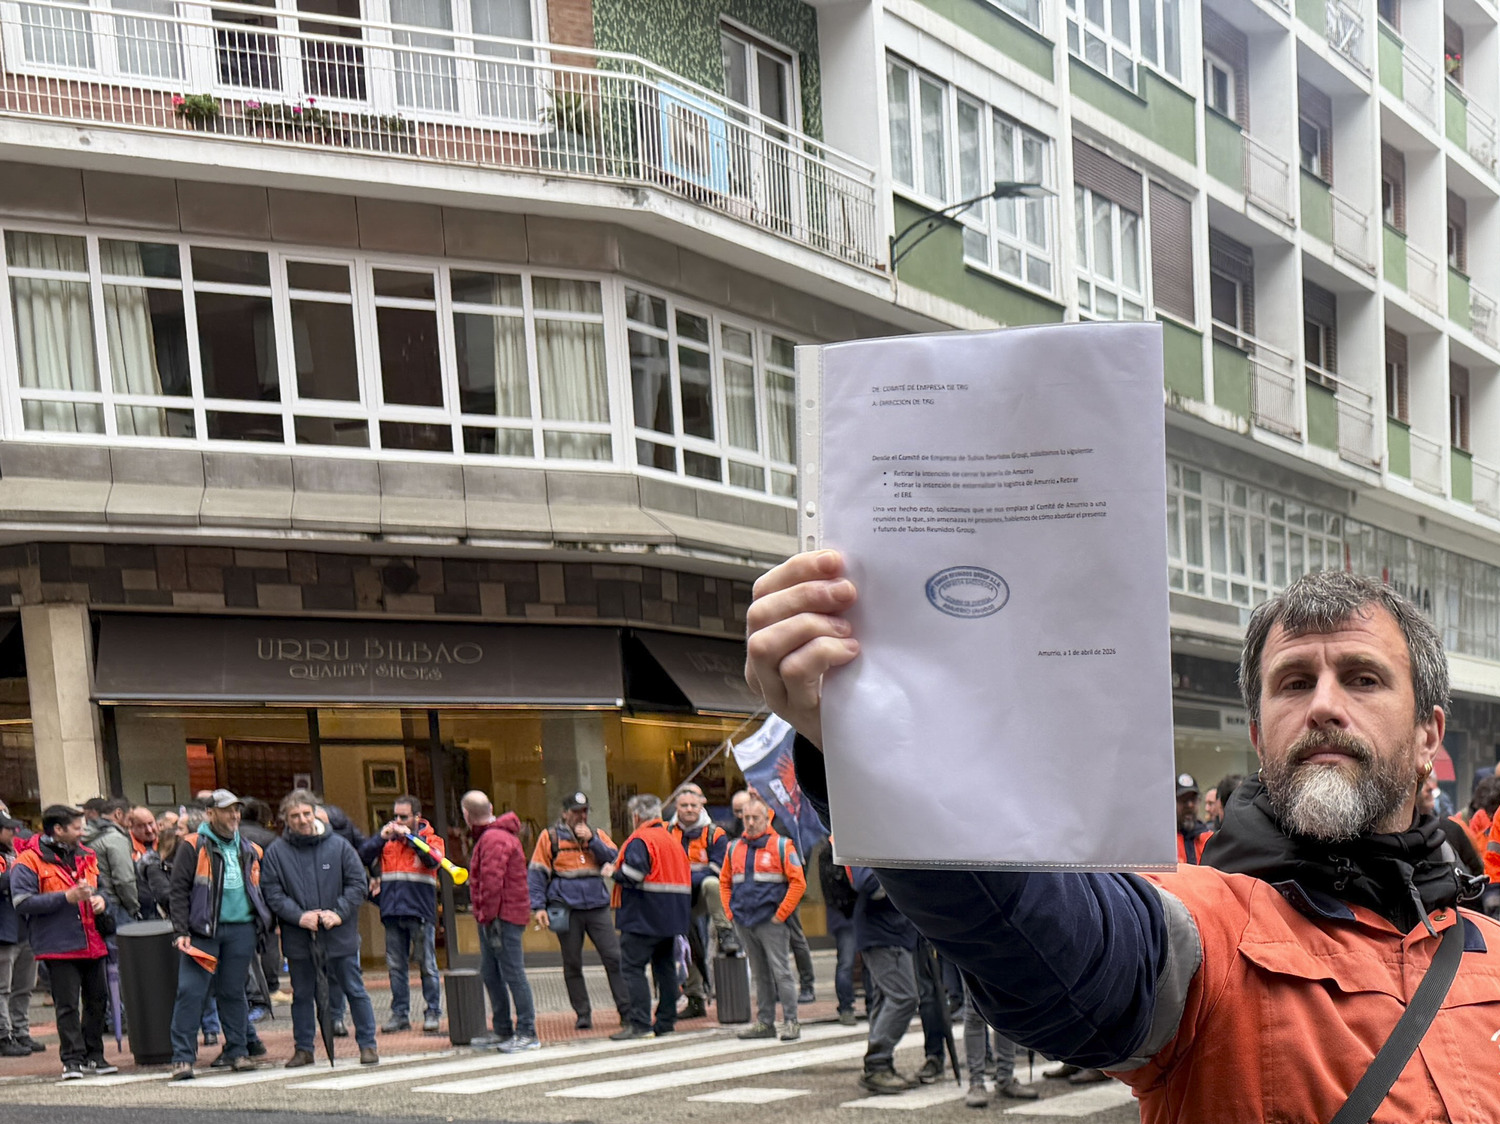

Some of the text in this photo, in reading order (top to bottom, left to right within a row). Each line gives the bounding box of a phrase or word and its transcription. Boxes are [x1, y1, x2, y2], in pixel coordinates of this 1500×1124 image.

[898, 505, 919, 513] hecho
[256, 637, 484, 665] URRU BILBAO
[289, 662, 443, 681] QUALITY SHOES
